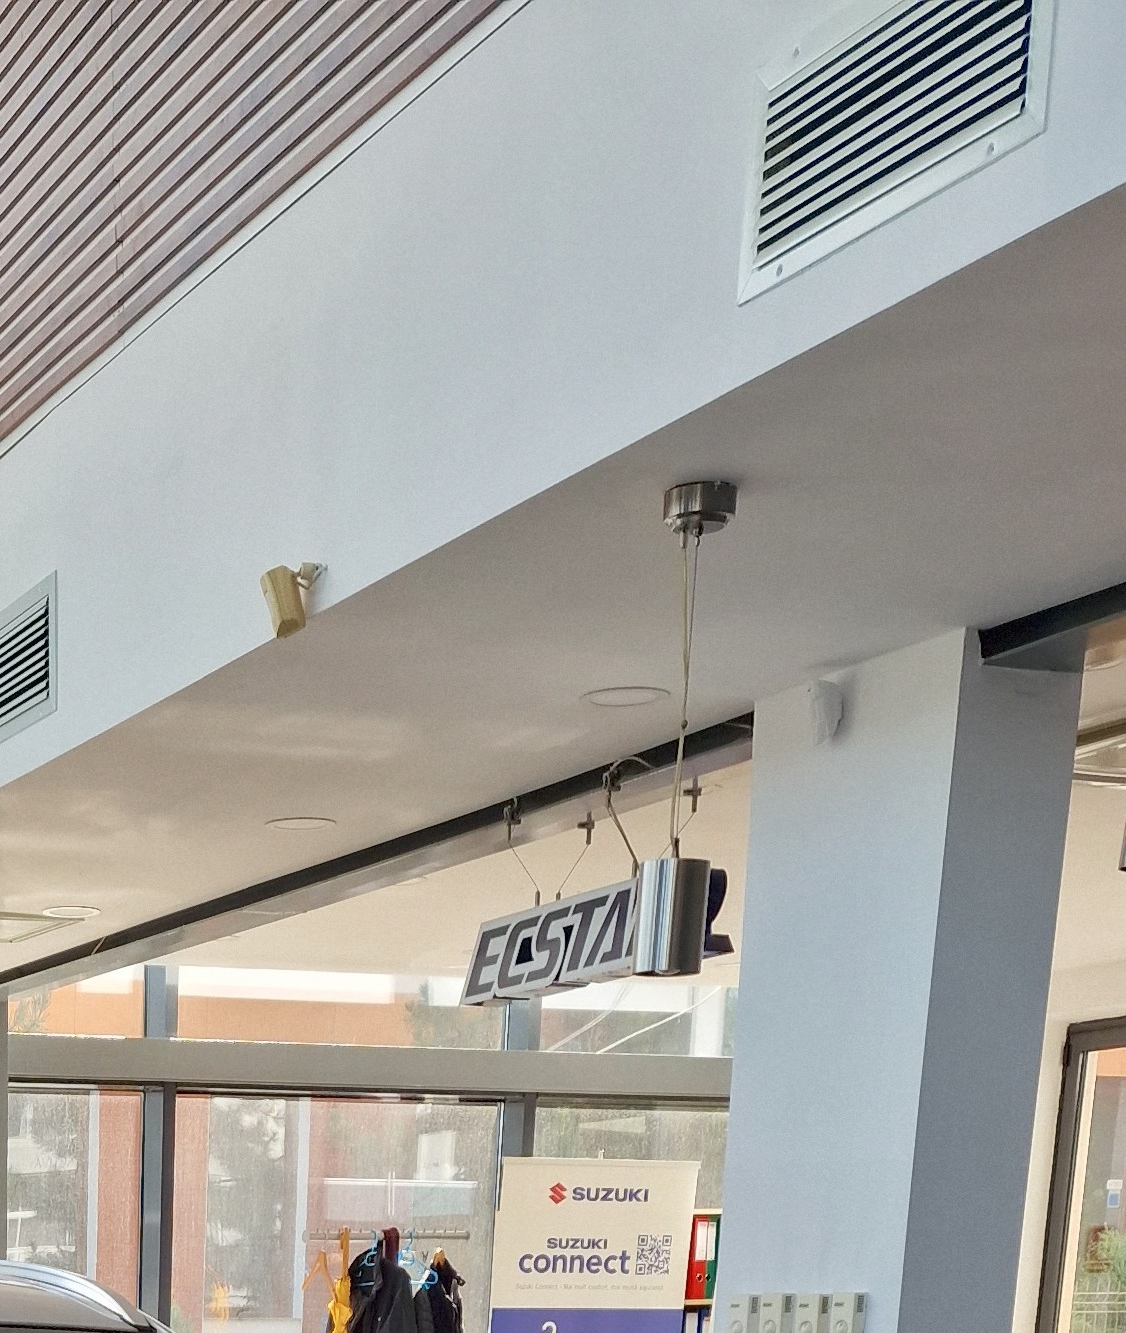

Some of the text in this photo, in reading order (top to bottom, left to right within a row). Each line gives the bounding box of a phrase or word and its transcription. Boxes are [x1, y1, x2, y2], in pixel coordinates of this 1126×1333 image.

[465, 888, 640, 998] ECSTA
[572, 1187, 649, 1203] SUZUKI
[546, 1237, 608, 1250] SUZUKI
[518, 1249, 631, 1275] connect
